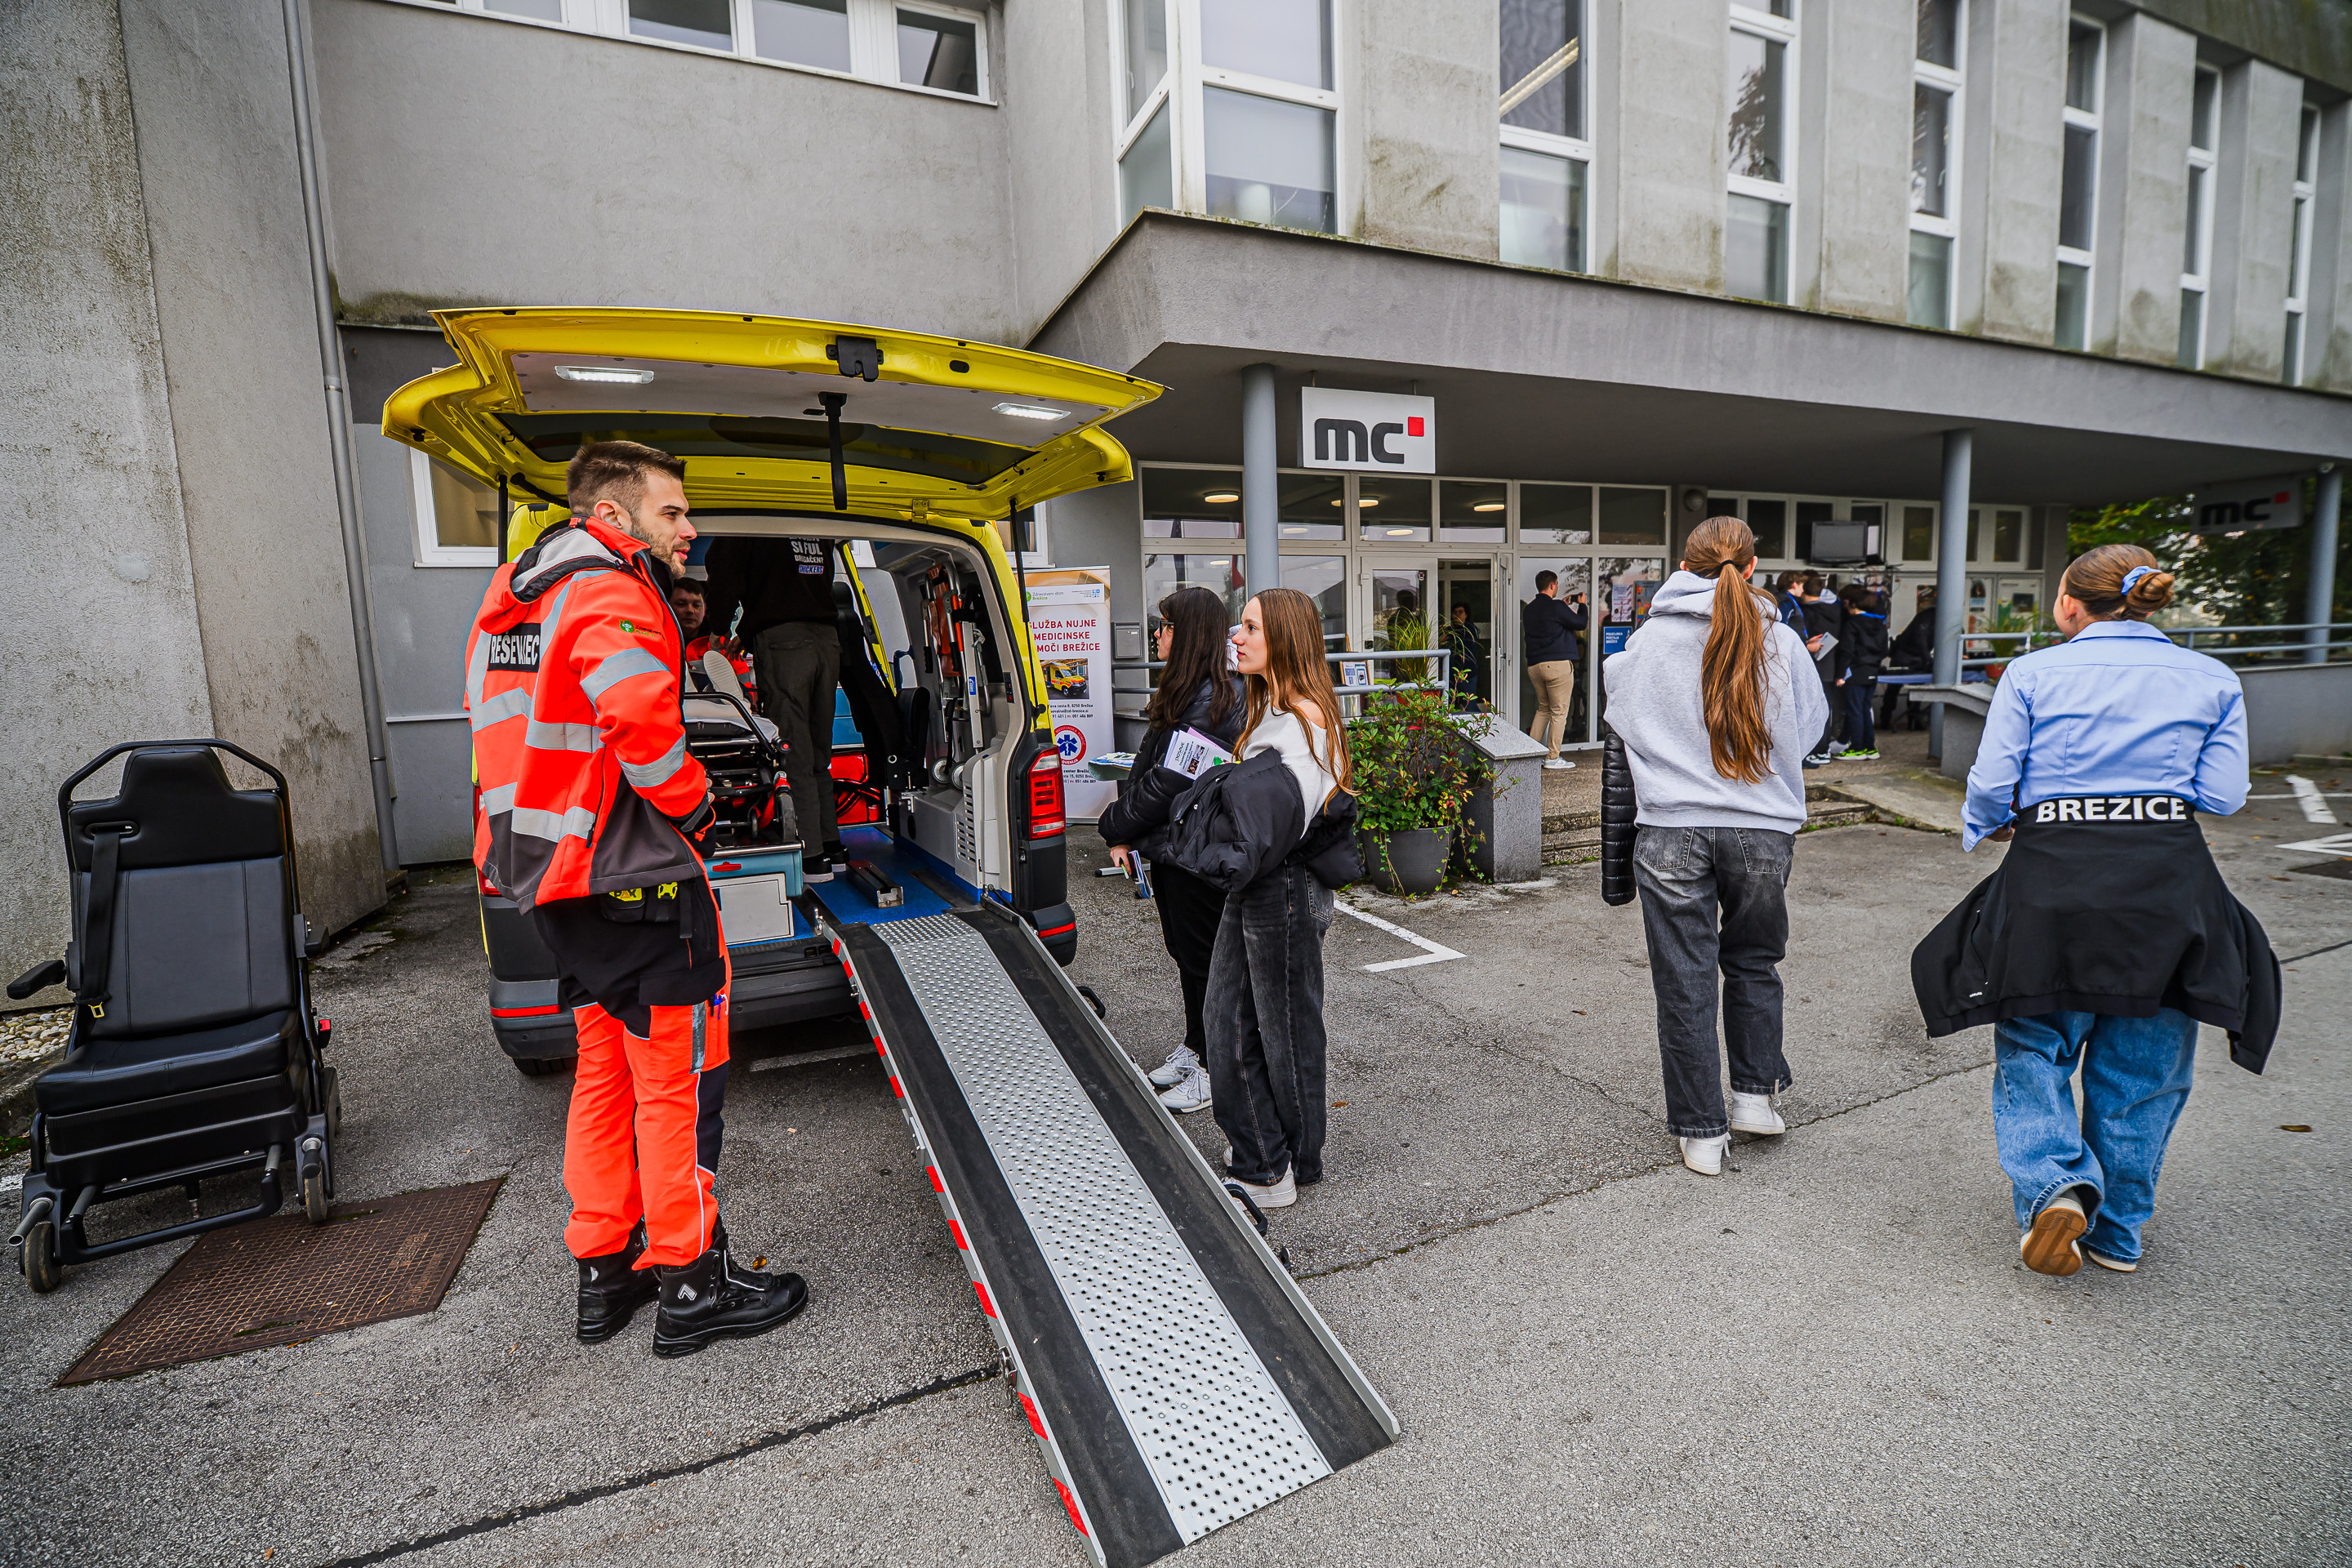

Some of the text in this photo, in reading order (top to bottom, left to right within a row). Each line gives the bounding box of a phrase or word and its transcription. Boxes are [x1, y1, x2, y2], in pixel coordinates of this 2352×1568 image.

[1315, 418, 1405, 465] mc
[2199, 497, 2272, 526] mc
[791, 541, 822, 555] SI FUL
[1066, 619, 1097, 628] NUJNE
[1033, 631, 1090, 641] MEDICINSKE
[1036, 642, 1101, 653] MOČI BREŽICE
